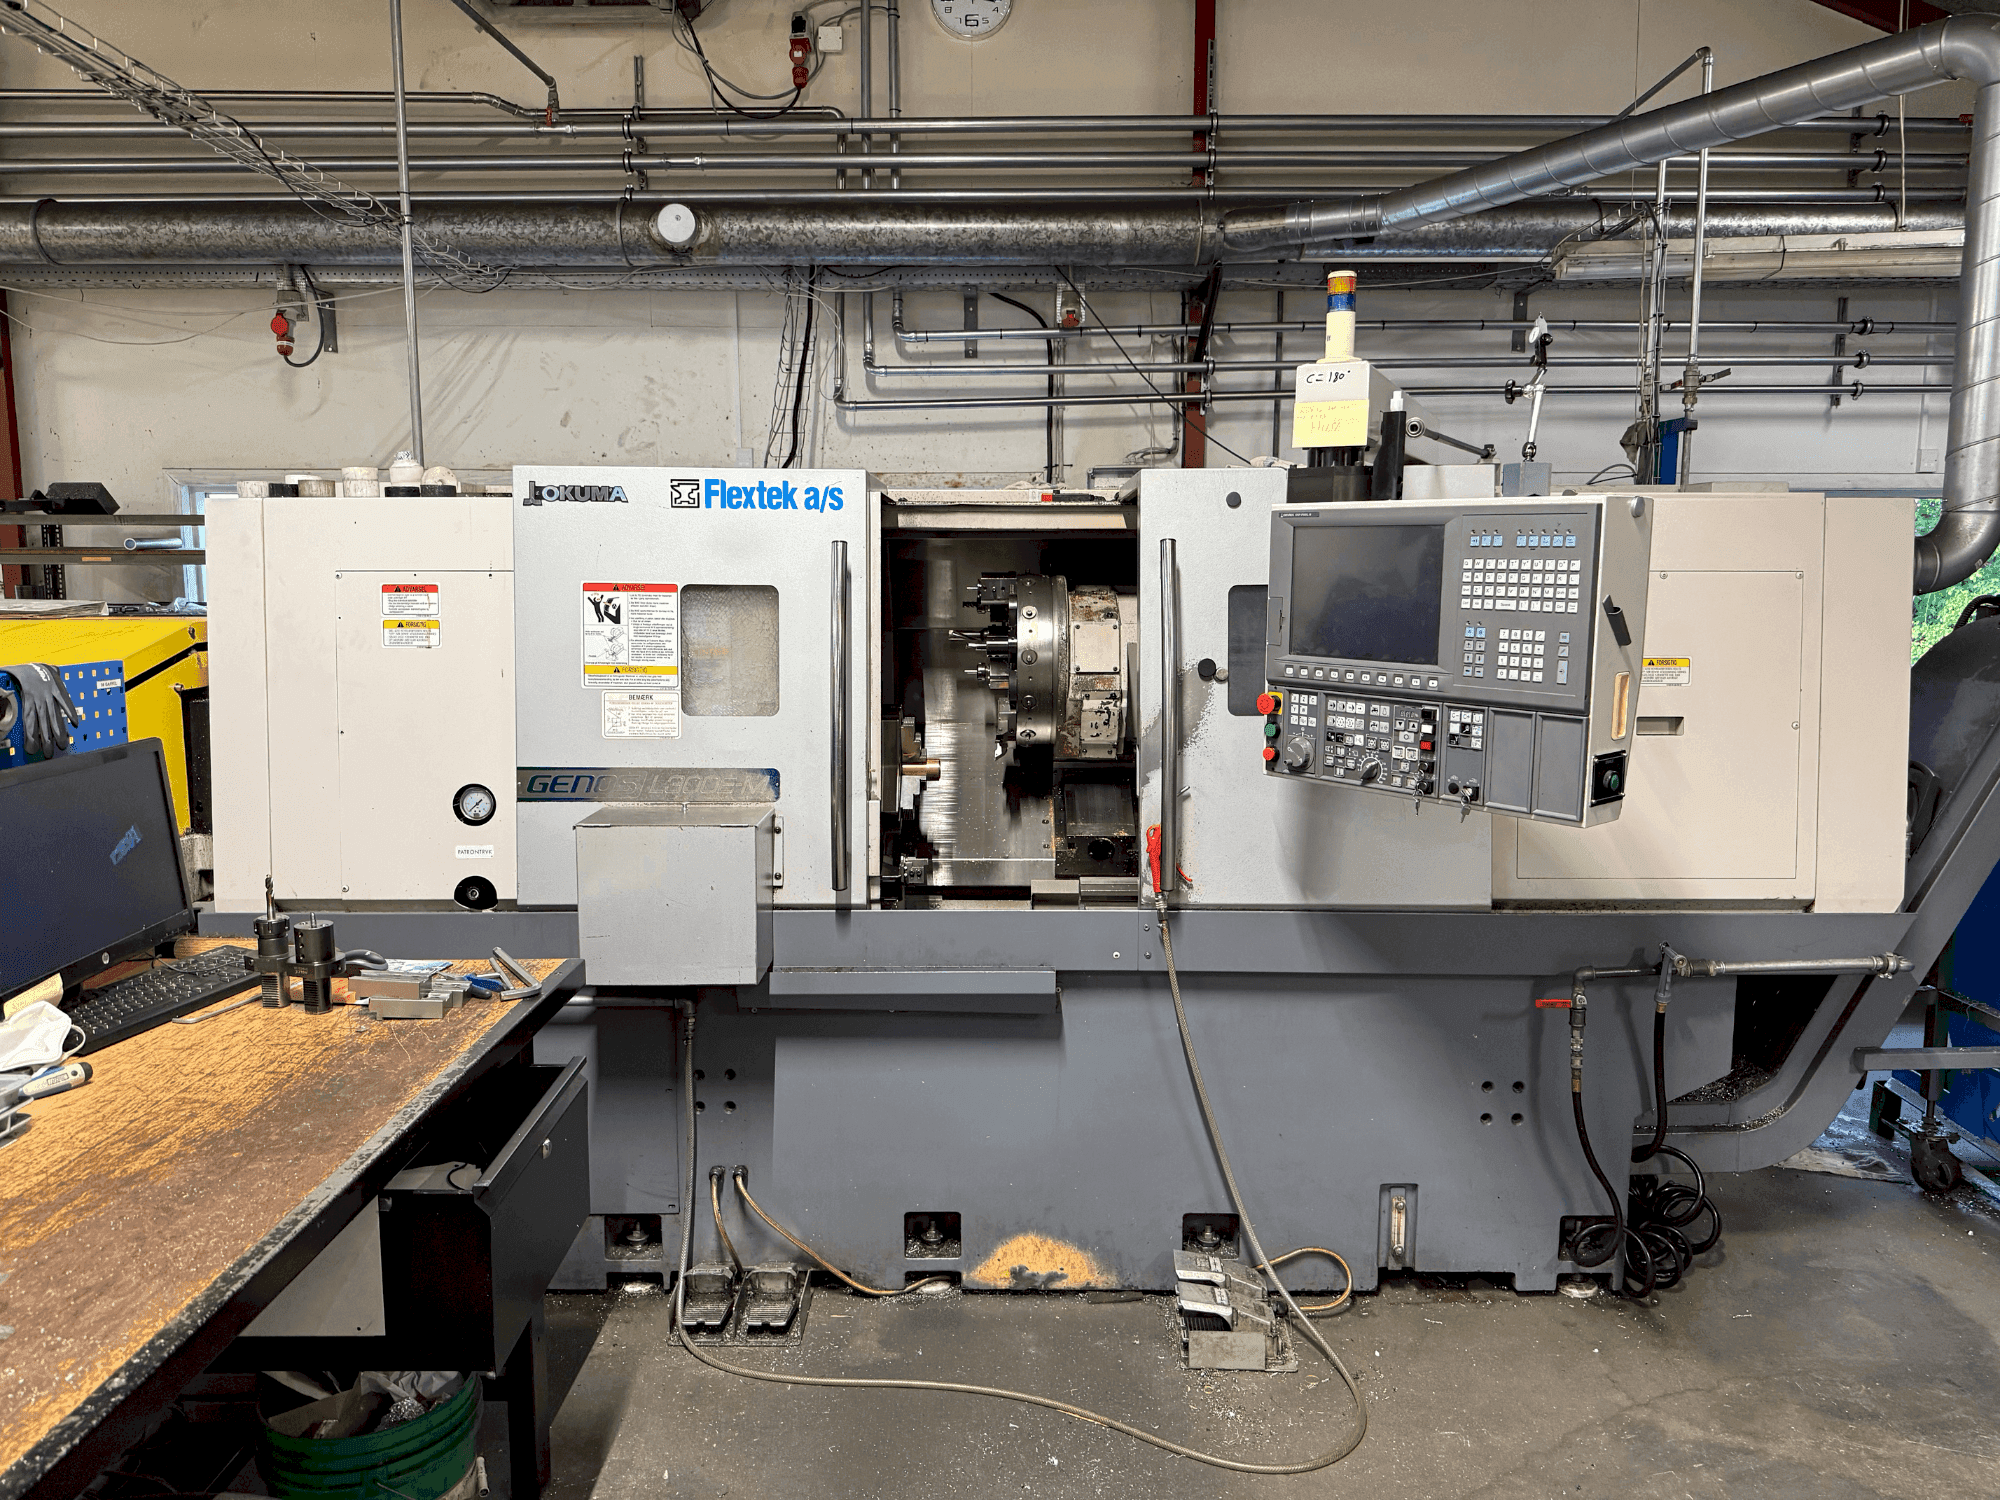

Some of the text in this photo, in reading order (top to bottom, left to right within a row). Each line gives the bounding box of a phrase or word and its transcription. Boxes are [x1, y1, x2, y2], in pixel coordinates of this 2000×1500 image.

[944, 6, 953, 14] 8
[992, 6, 999, 14] 4
[964, 13, 979, 27] 6
[981, 16, 990, 24] 5
[541, 484, 629, 504] OKUMA
[704, 478, 844, 514] Flextek a/s
